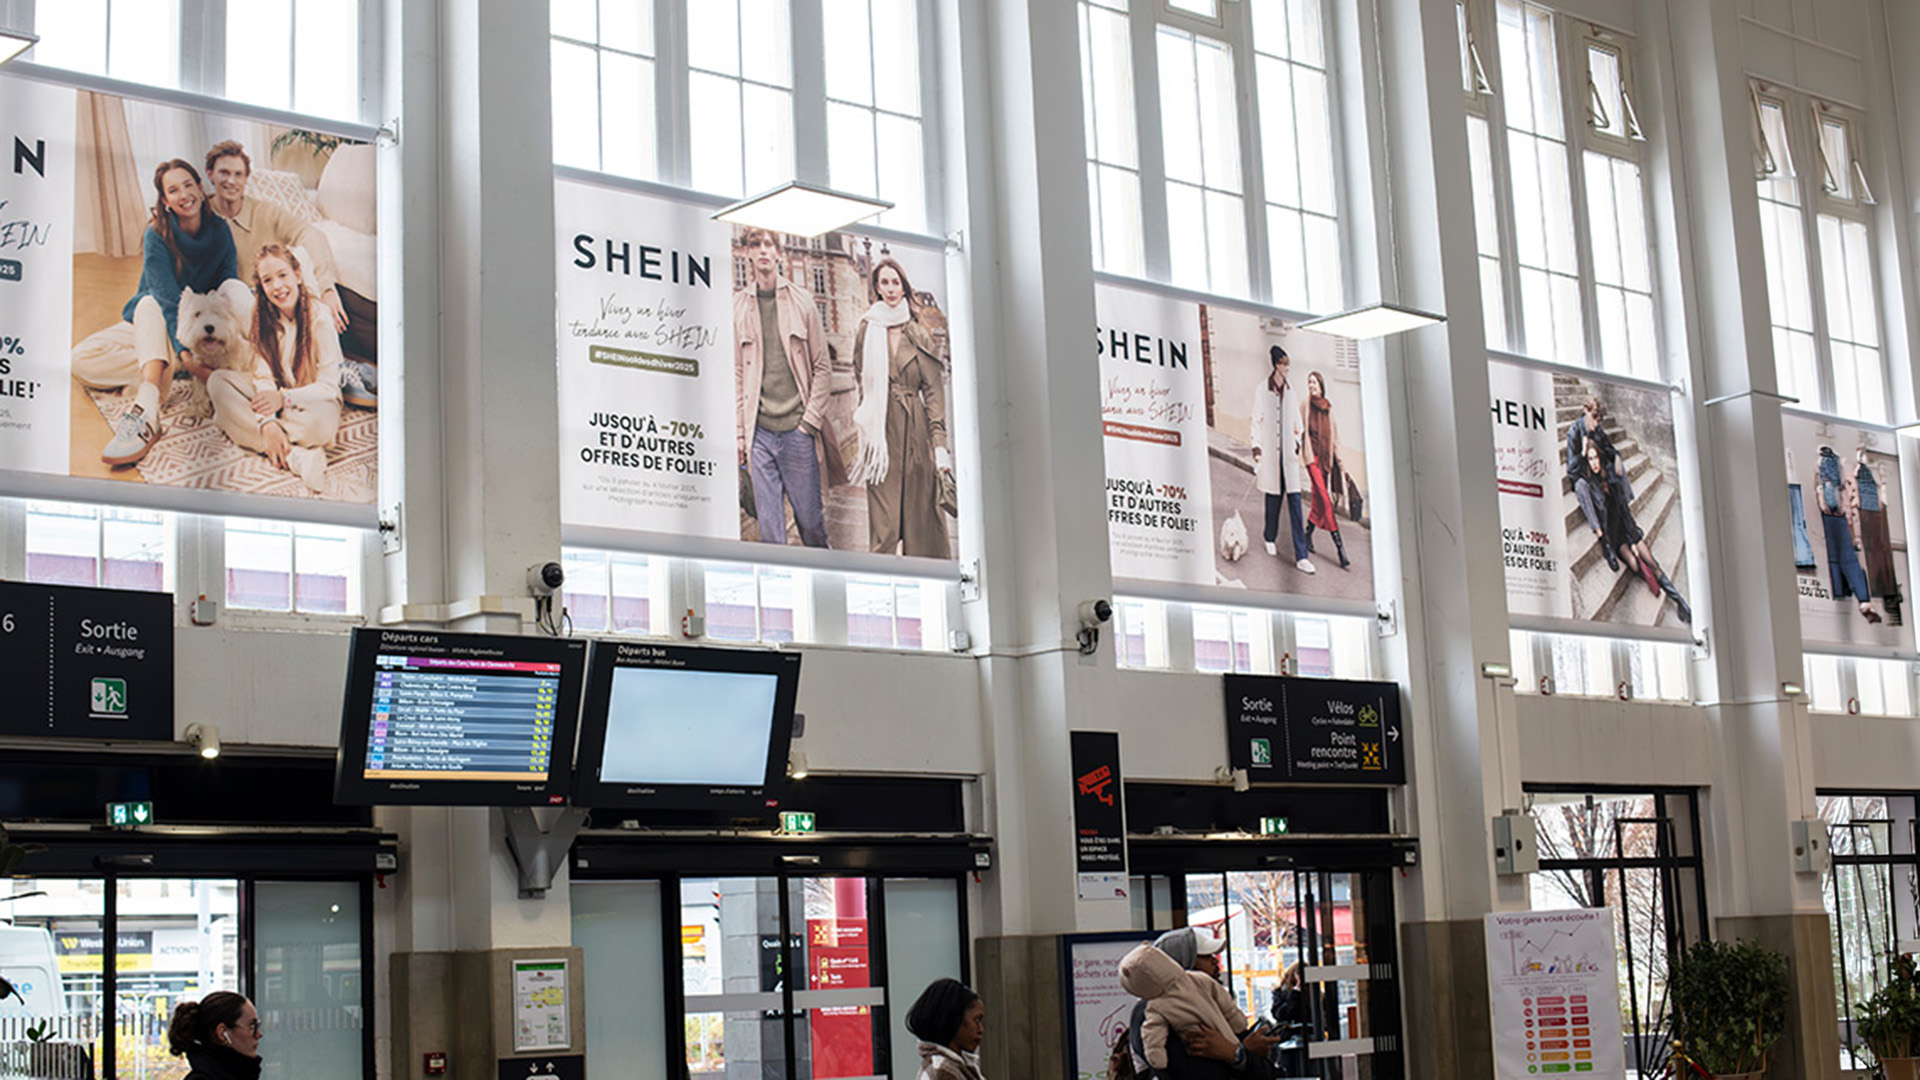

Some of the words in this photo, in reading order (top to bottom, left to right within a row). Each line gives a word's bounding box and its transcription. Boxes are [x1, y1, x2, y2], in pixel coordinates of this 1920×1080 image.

[574, 234, 711, 289] SHEIN
[655, 324, 718, 350] SHEIN
[589, 412, 659, 434] JUSQU'À
[661, 421, 704, 440] -70%
[600, 432, 617, 447] ET
[621, 434, 696, 456] D'AUTRES
[580, 448, 640, 469] OFFRES
[643, 456, 663, 471] DE
[1156, 484, 1187, 500] -70%
[1112, 495, 1125, 507] ET
[1128, 496, 1182, 515] D'AUTRES
[1144, 514, 1158, 527] DE
[2, 613, 15, 632] 6
[81, 619, 138, 641] Sortie
[381, 632, 417, 643] Départs
[420, 635, 439, 643] cars
[75, 643, 94, 654] Exit
[103, 644, 145, 659] Ausgang
[618, 645, 650, 656] Départs
[652, 648, 666, 656] bus
[1242, 696, 1273, 712] Sortie
[1327, 700, 1354, 715] Vélos
[1331, 732, 1357, 746] Point
[1311, 747, 1357, 759] rencontre
[1496, 916, 1520, 925] Votre
[1523, 916, 1541, 926] gare
[1544, 914, 1563, 923] vous
[1565, 912, 1594, 922] écoute
[117, 937, 145, 948] Union
